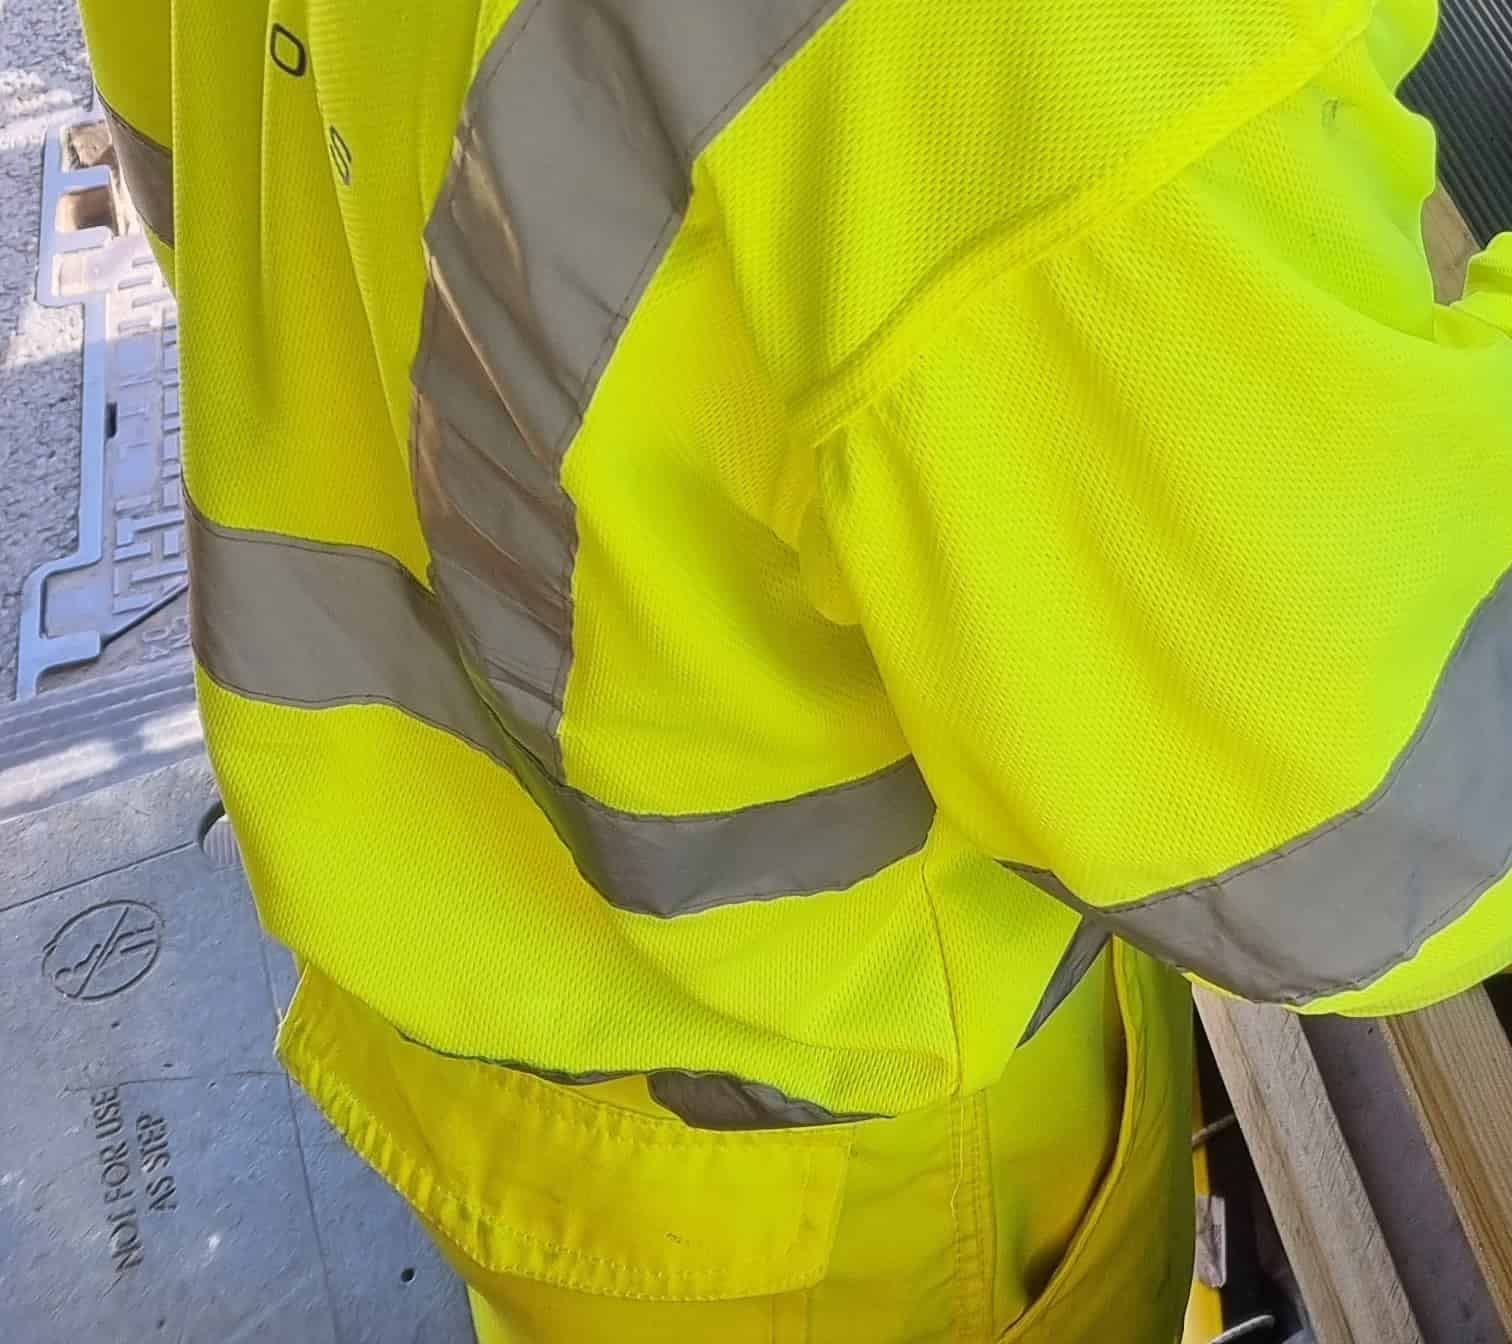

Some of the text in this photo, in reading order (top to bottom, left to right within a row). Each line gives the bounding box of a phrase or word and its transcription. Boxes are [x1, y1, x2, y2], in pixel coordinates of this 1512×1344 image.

[91, 1087, 144, 1273] NOT FOR USE
[136, 1111, 177, 1211] AS STEP
